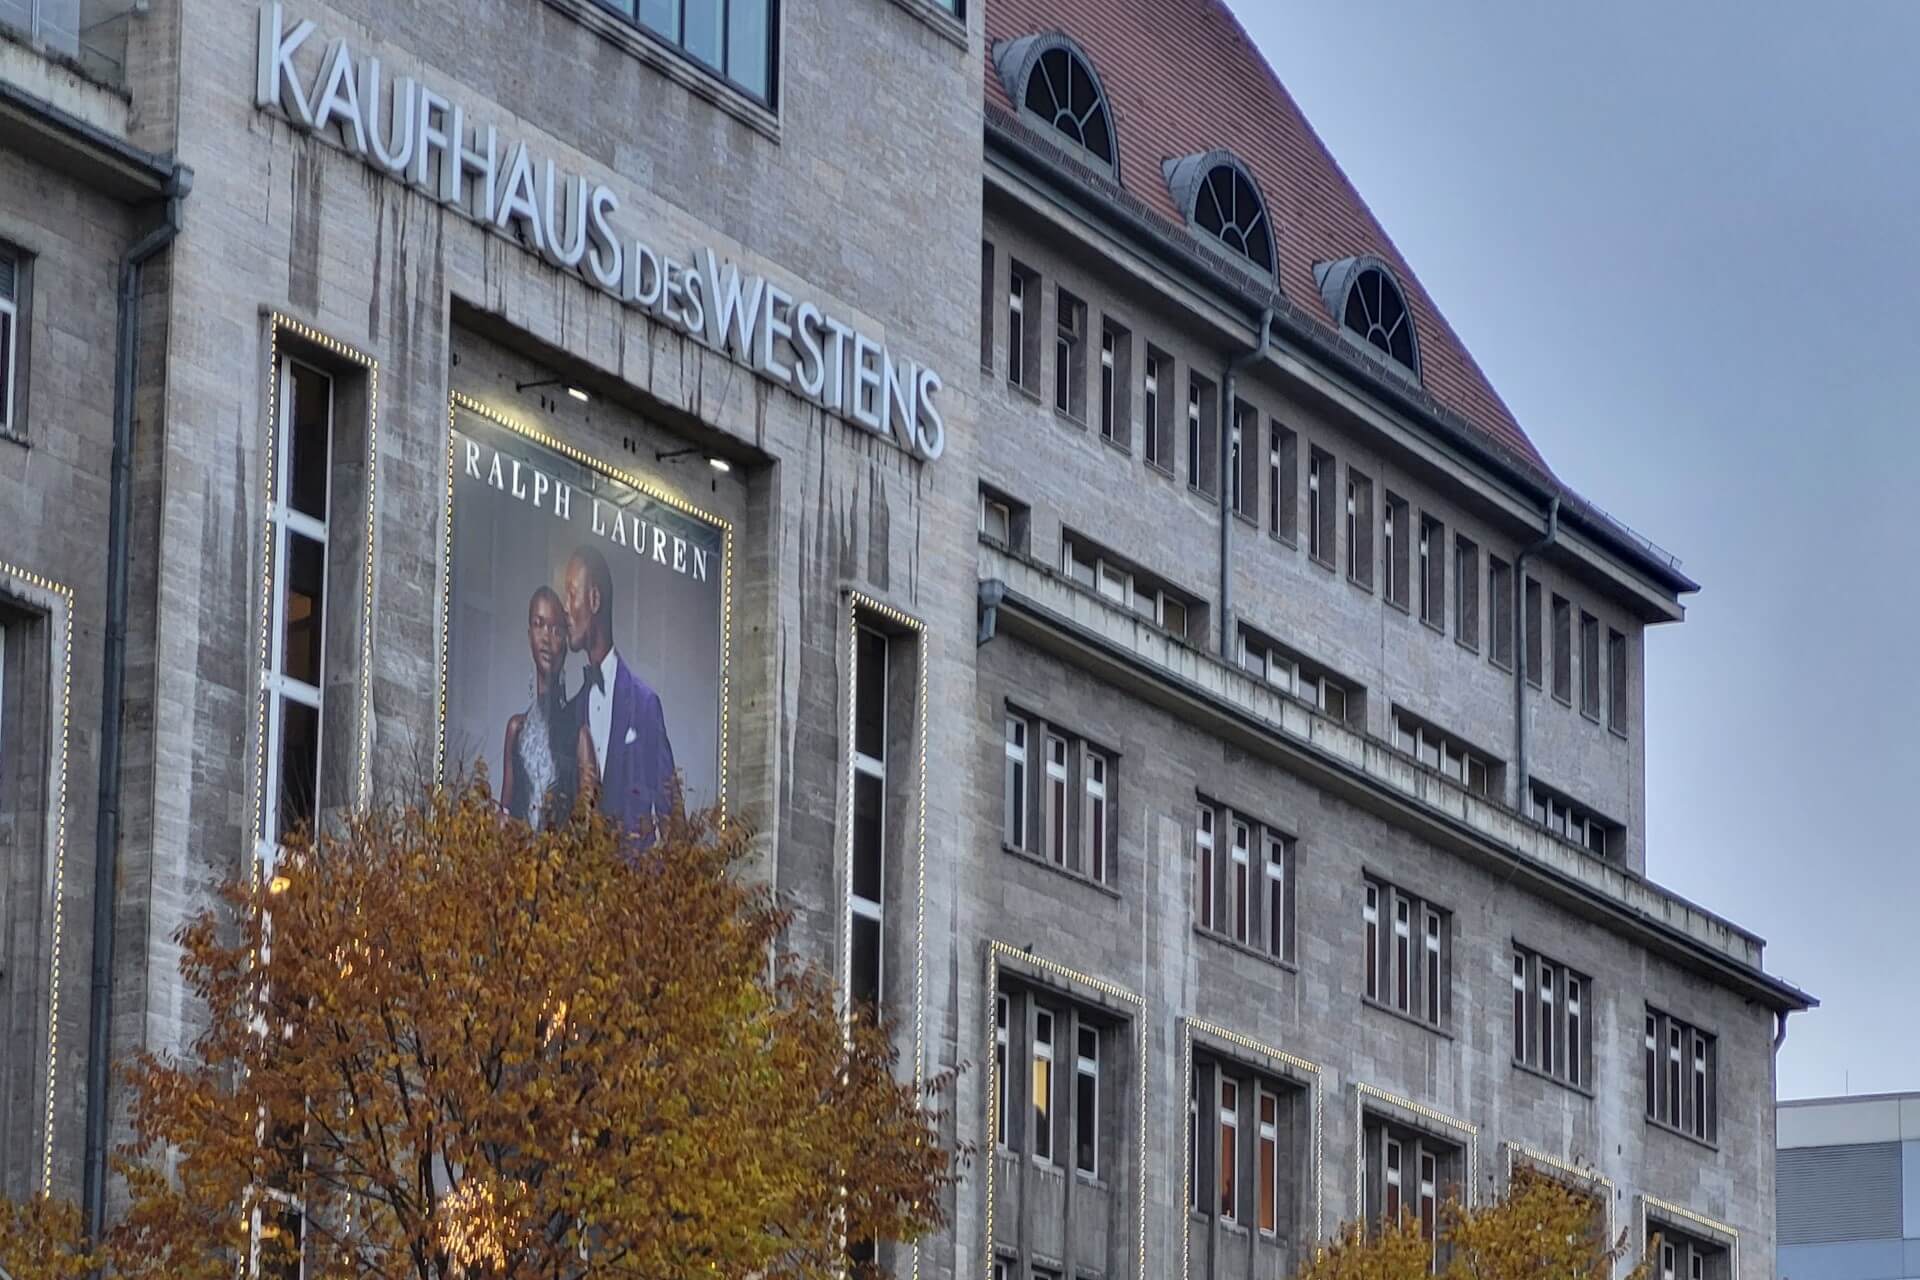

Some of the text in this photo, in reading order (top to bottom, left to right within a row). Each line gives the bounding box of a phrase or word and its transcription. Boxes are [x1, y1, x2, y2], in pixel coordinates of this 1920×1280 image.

[257, 2, 945, 461] KAUFHAUS DES WESTENS
[464, 439, 708, 582] RALPH LAUREN
